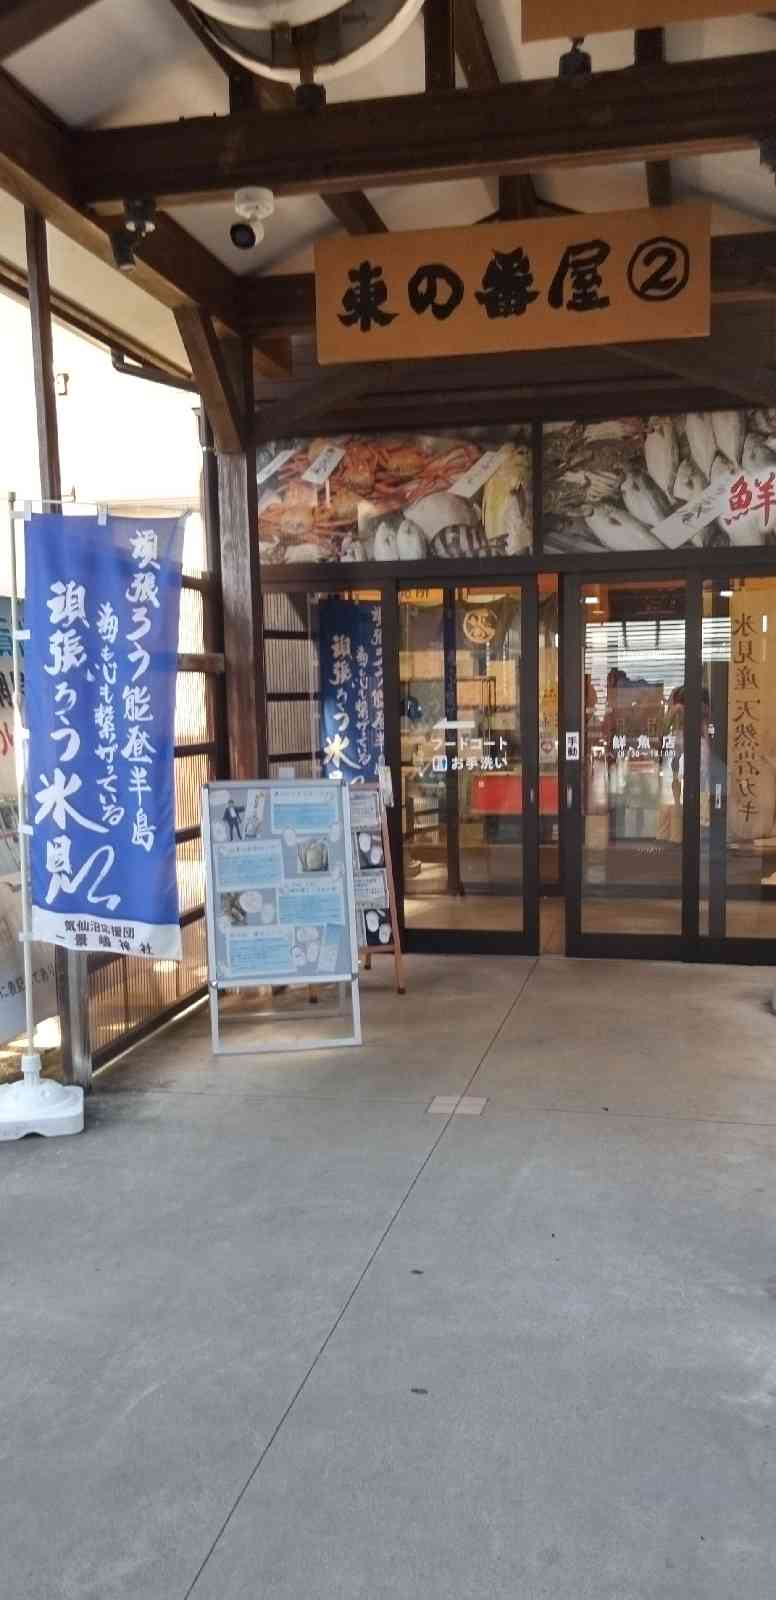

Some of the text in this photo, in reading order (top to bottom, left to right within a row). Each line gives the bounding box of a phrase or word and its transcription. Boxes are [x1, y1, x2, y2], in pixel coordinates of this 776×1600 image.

[724, 472, 776, 527] 鮮
[122, 529, 161, 853] 頑張ろう能登半島
[34, 580, 120, 911] 頑張ろう氷見
[431, 736, 508, 751] フードコート
[451, 755, 508, 770] お手洗い
